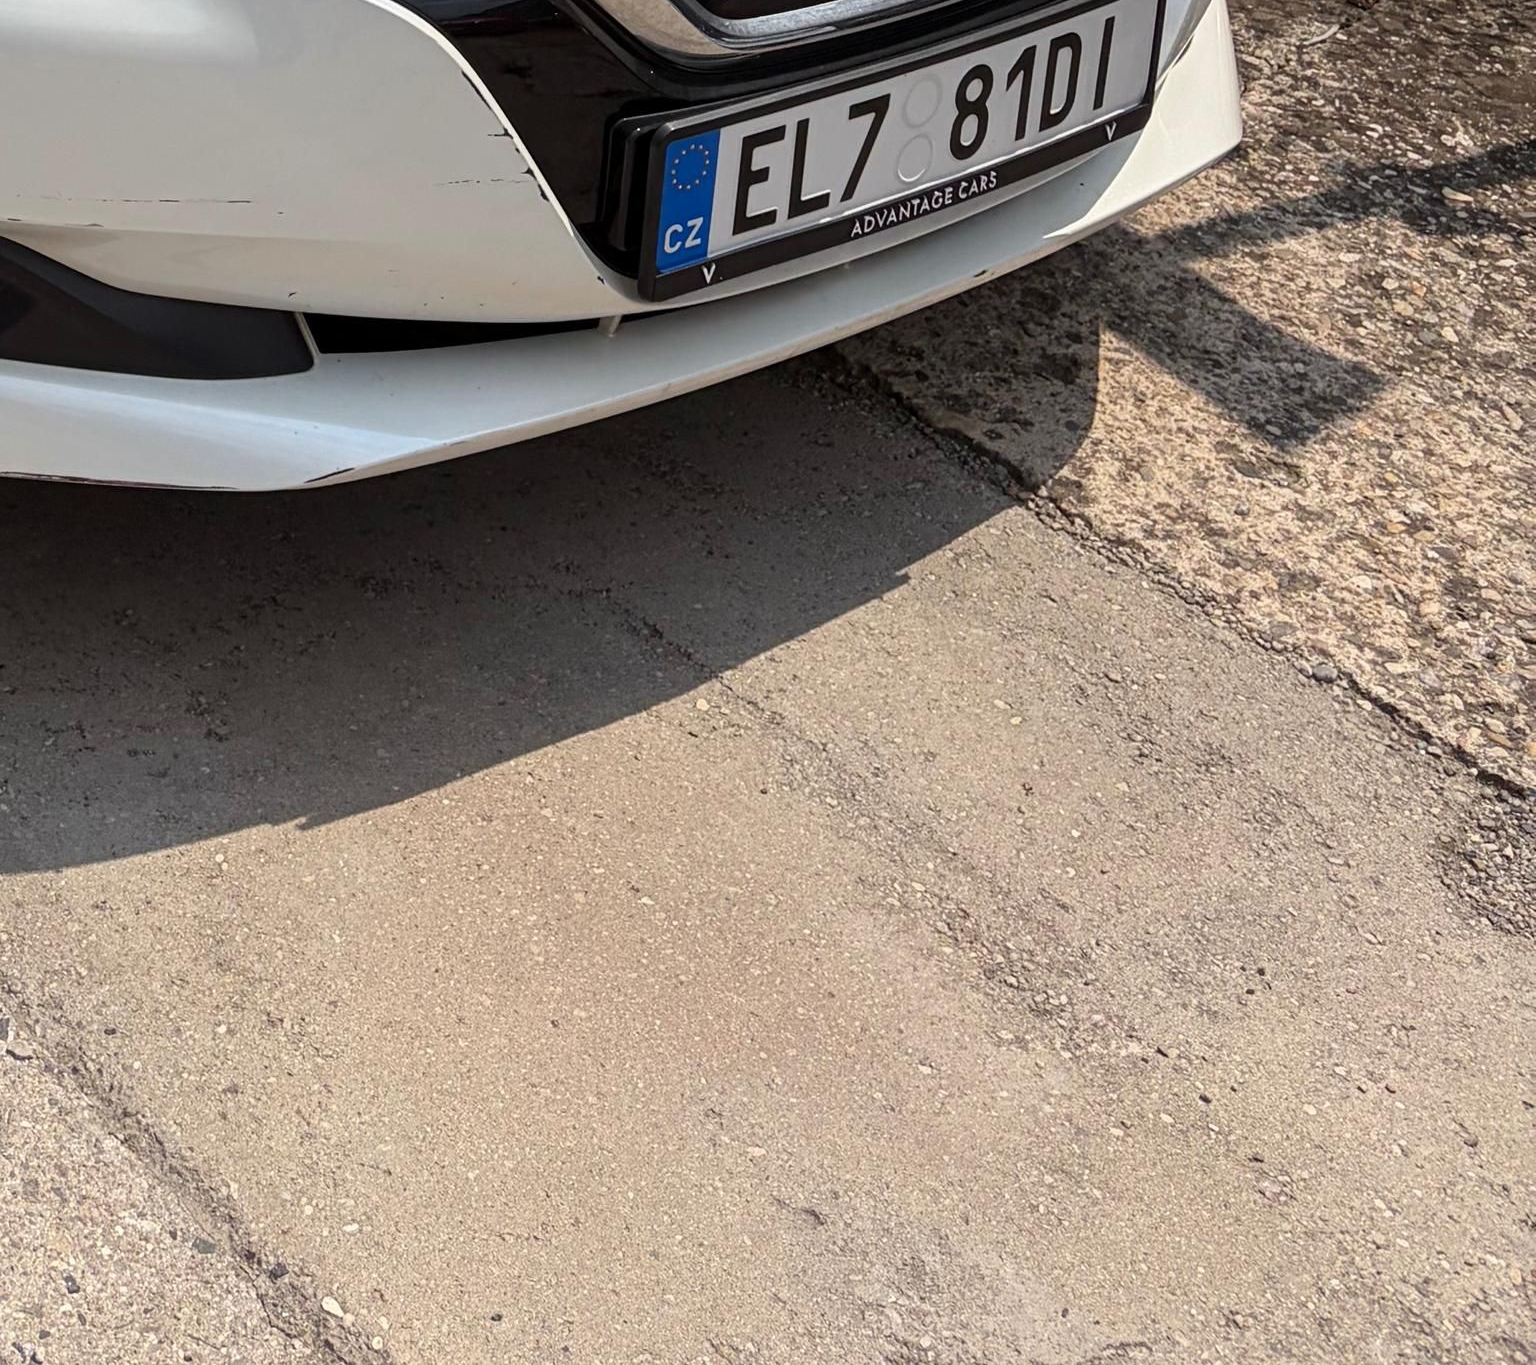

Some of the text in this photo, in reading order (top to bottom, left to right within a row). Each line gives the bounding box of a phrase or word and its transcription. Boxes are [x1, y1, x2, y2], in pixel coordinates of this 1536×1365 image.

[732, 16, 1115, 236] EL7 81DI
[664, 217, 704, 254] CZ
[851, 171, 997, 237] ADVANTAGE CARS
